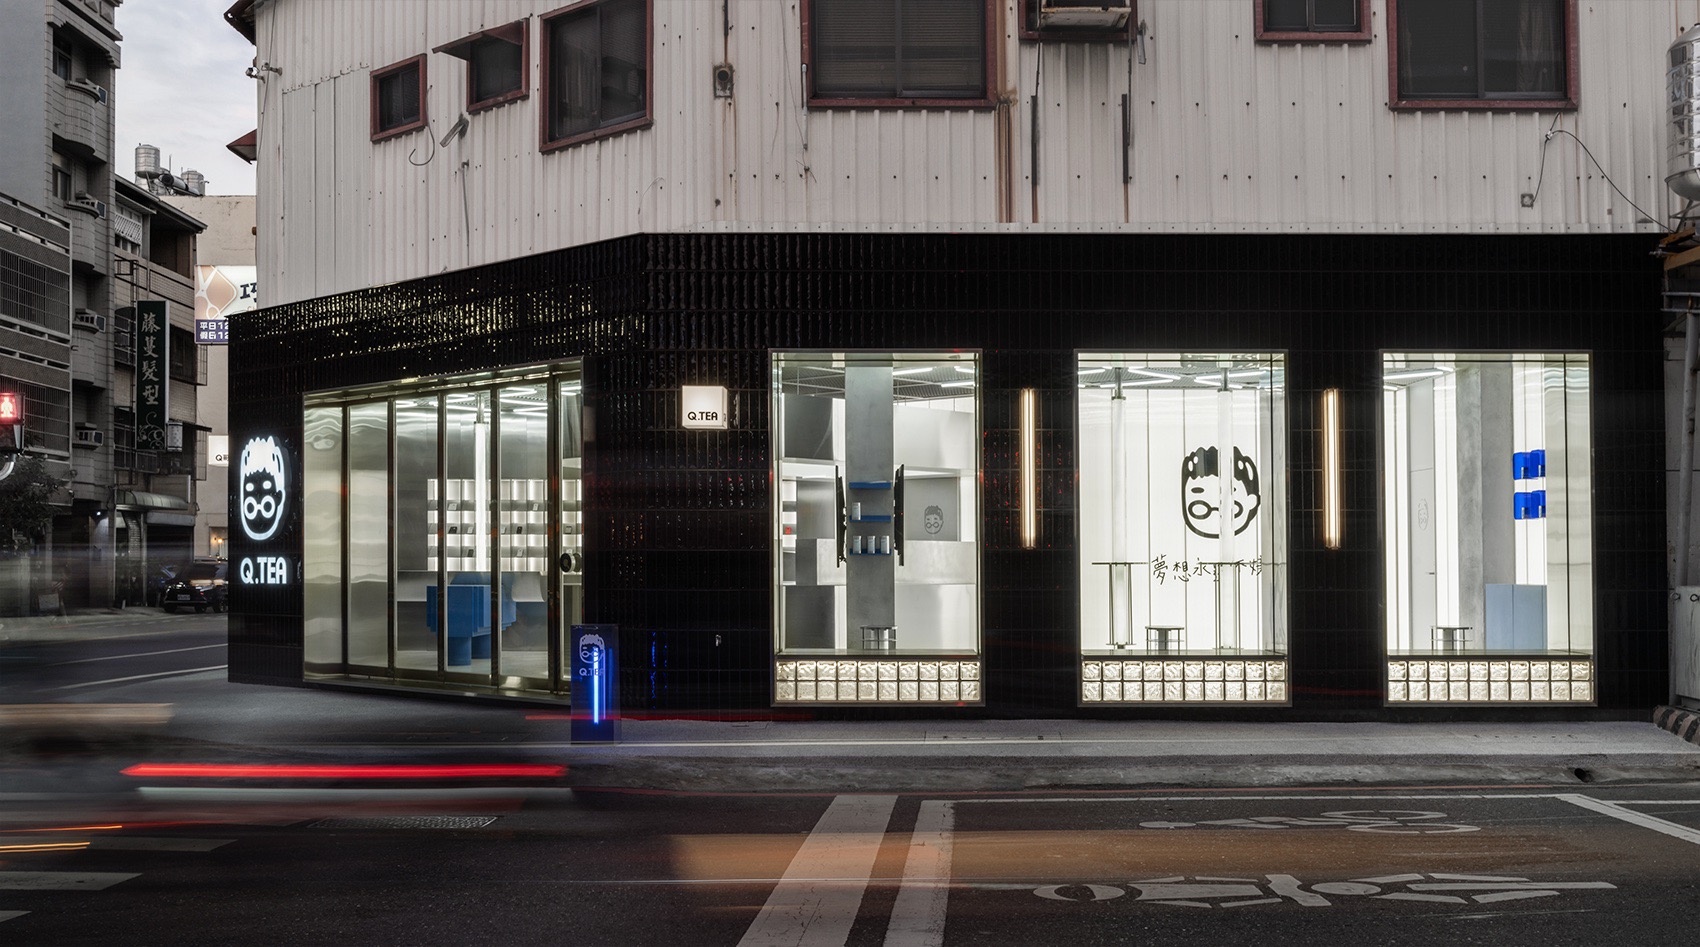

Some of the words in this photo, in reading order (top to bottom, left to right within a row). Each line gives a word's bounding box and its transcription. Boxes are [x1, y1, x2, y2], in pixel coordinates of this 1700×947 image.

[140, 312, 161, 406] 藤蔓髮型
[687, 411, 718, 421] Q.TEA
[240, 556, 287, 585] Q.TEA
